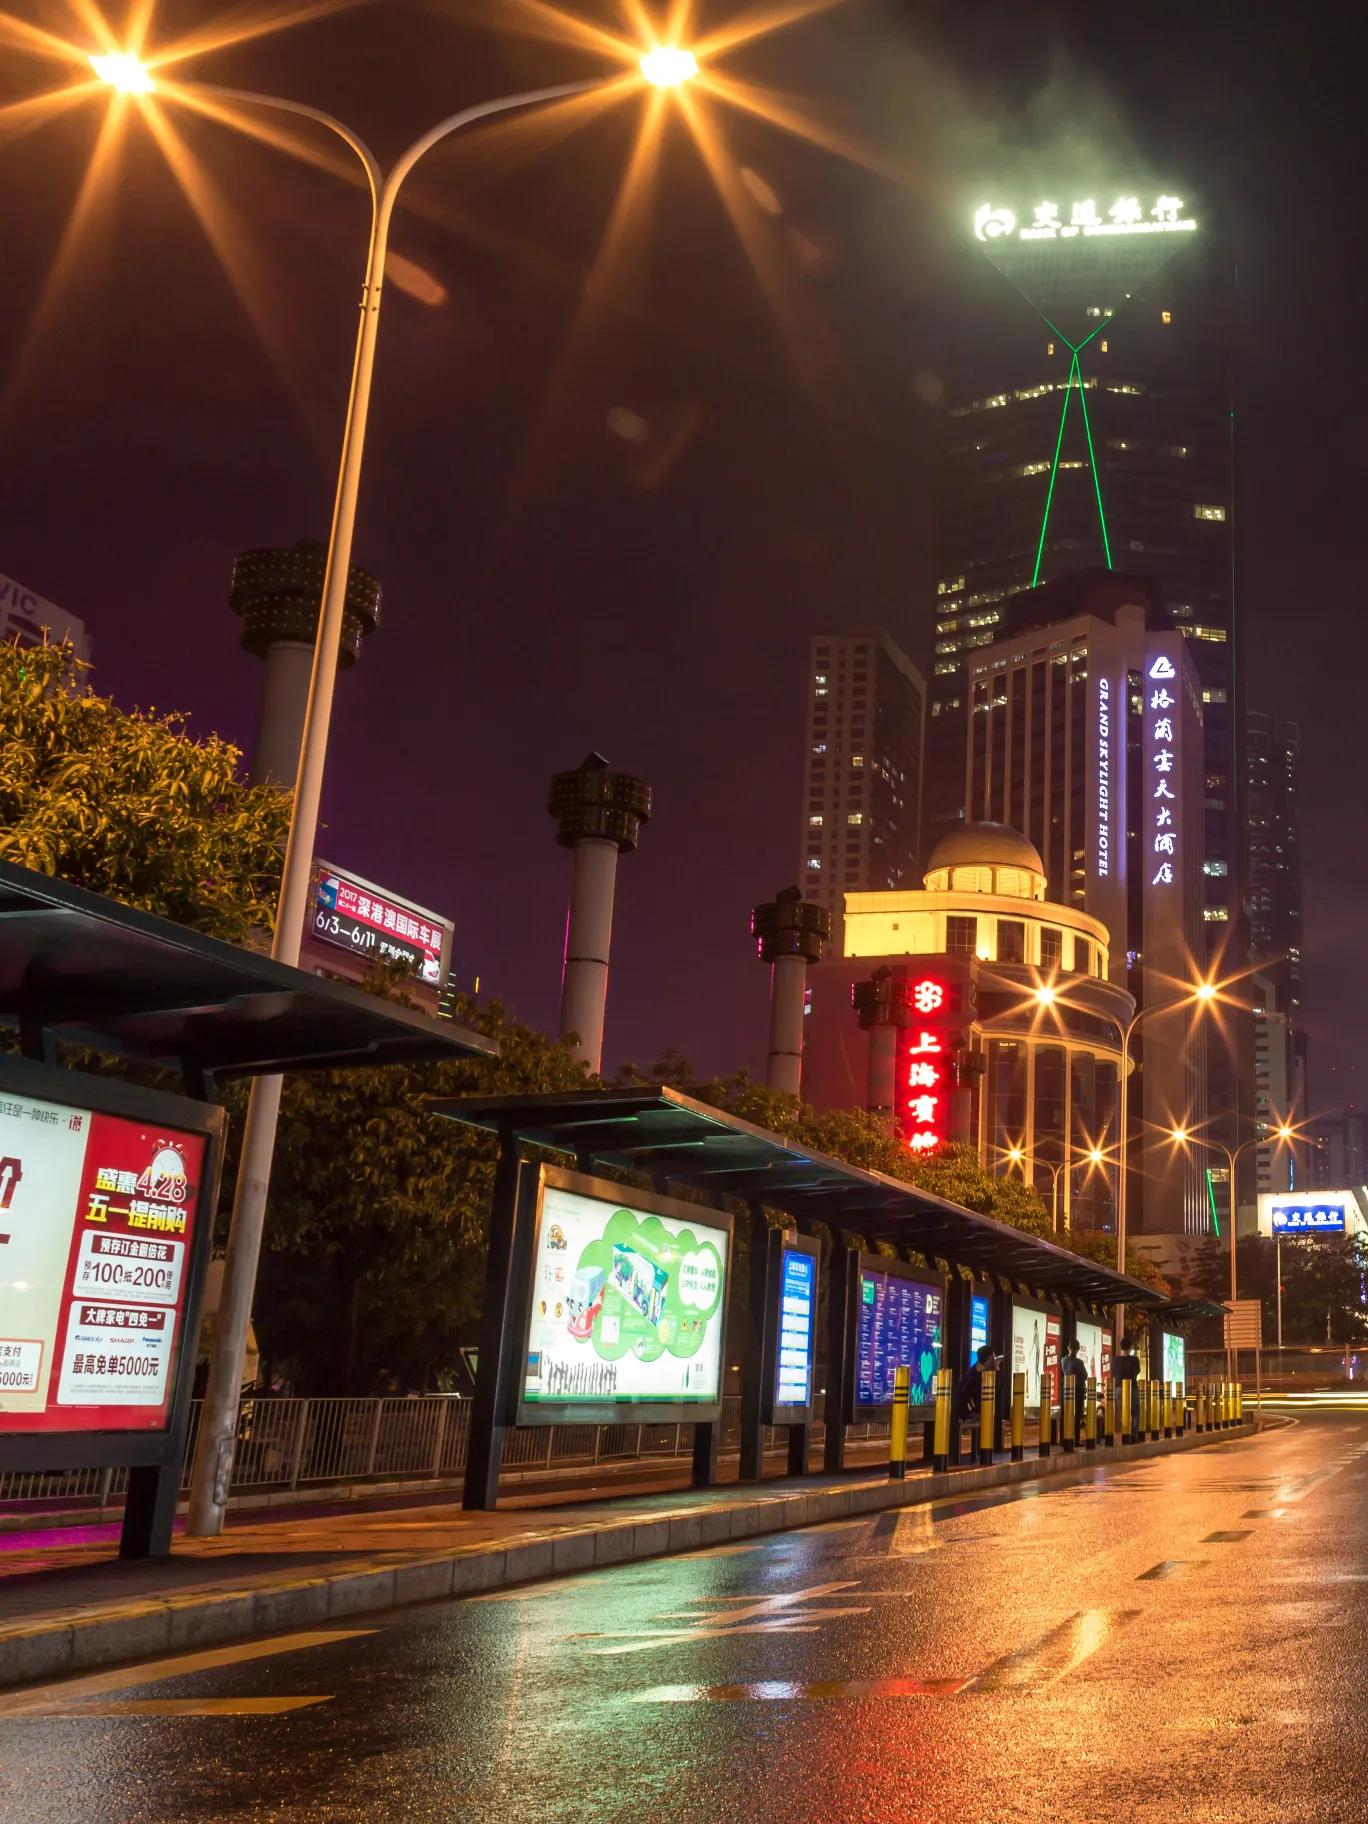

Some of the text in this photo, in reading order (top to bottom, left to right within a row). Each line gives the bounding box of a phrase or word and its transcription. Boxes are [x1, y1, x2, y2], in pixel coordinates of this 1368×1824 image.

[1098, 678, 1109, 877] GRAND SKYLIGHT HOTEL
[339, 887, 358, 903] 2017
[357, 895, 442, 951] 深港澳国际车展
[85, 1192, 188, 1234] 五一提前购
[72, 1353, 160, 1377] 最高免单5000元
